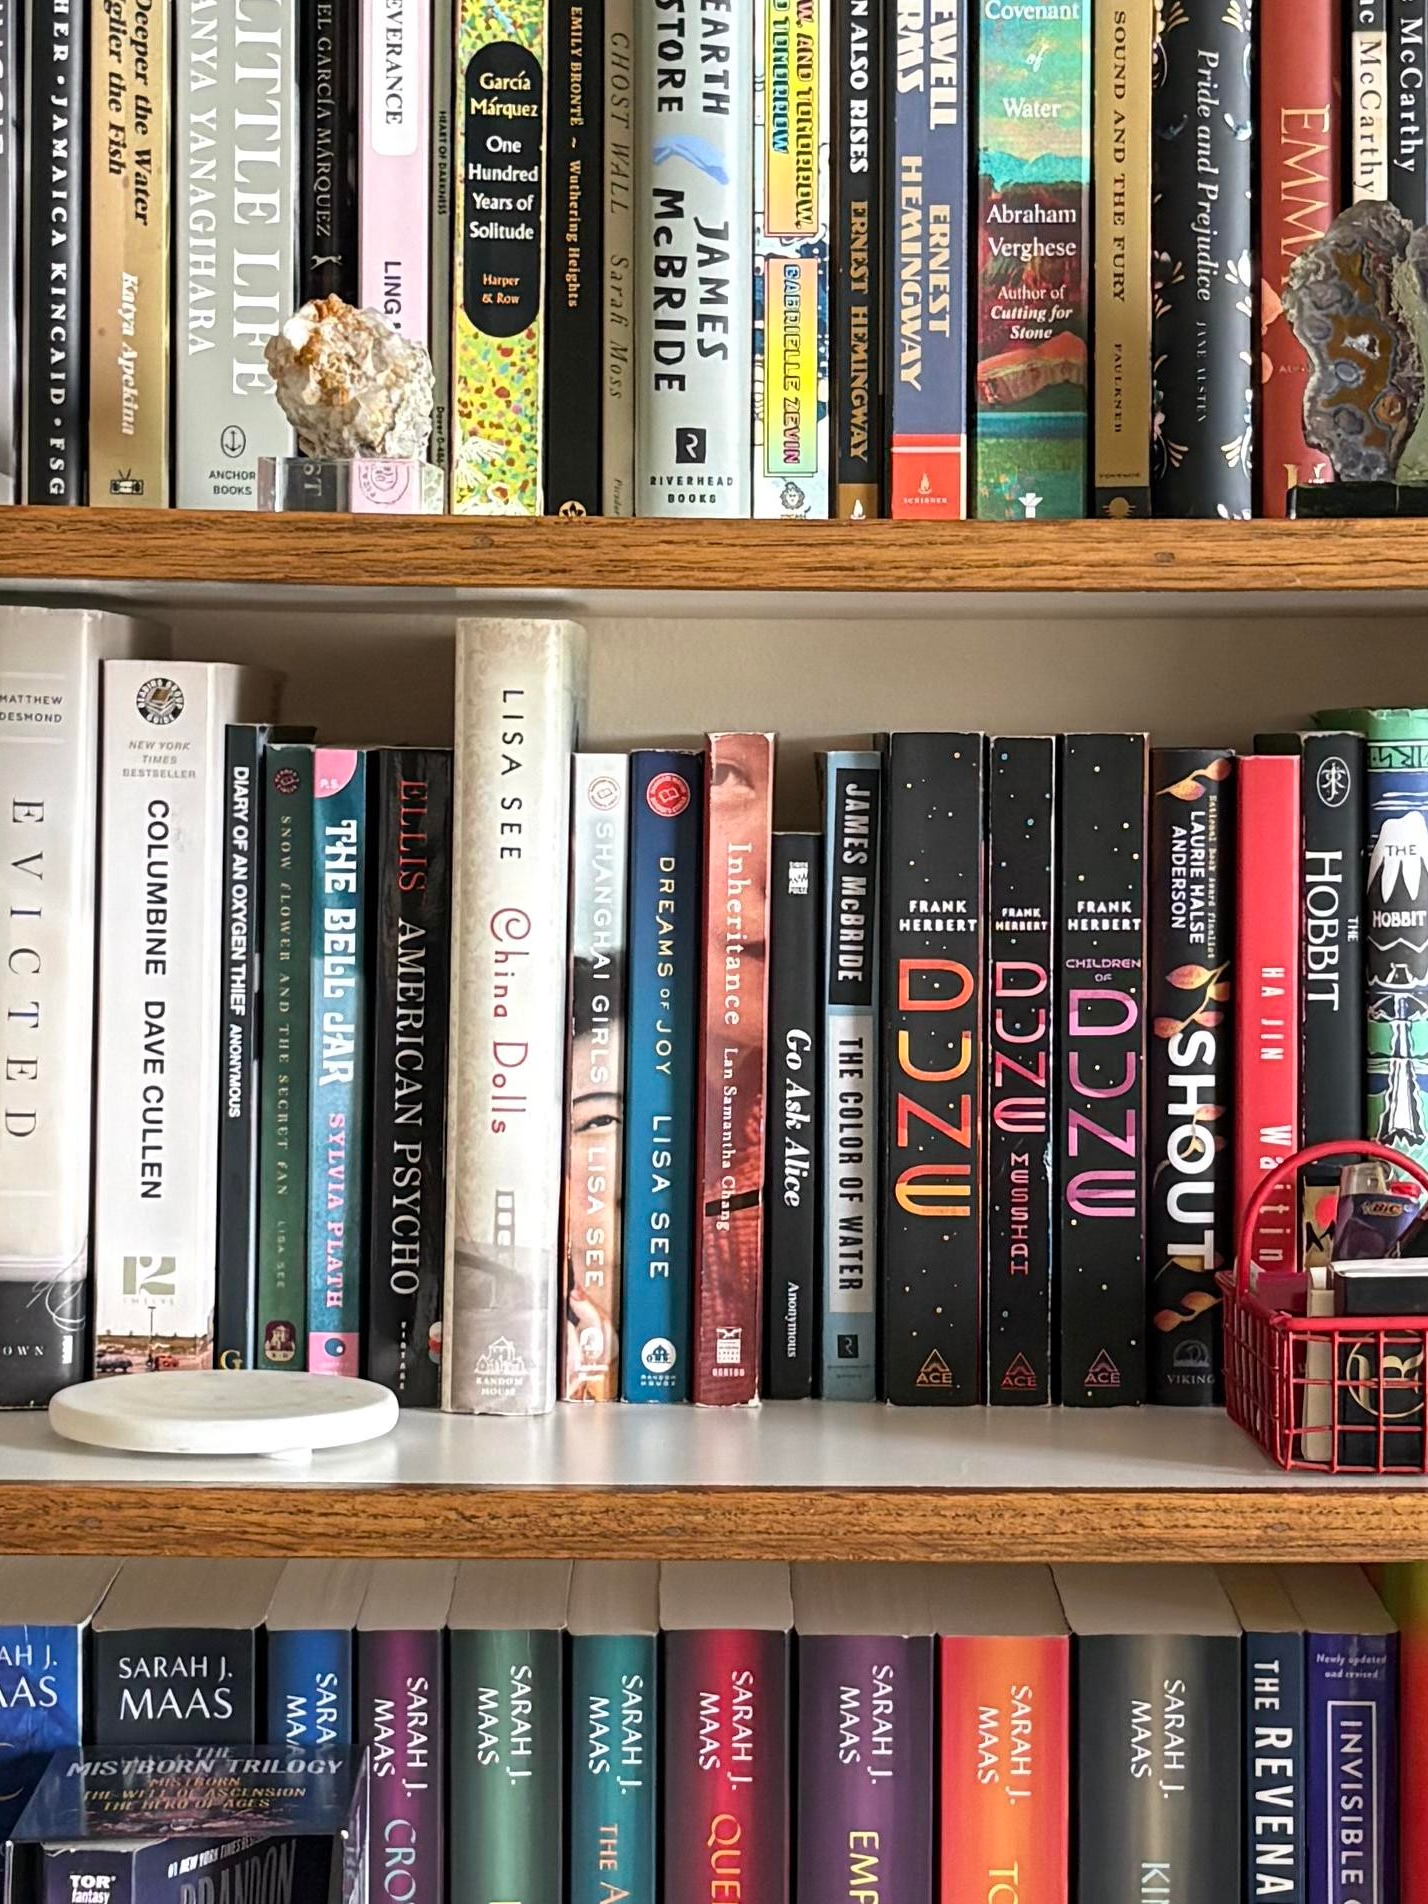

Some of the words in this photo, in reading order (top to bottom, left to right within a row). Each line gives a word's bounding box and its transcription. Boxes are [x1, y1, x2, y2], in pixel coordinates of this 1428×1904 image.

[984, 0, 1079, 21] Covenant
[1026, 45, 1045, 70] of
[479, 71, 532, 93] García
[470, 97, 539, 120] Márquez
[1002, 98, 1062, 119] Water
[486, 135, 522, 155] One
[468, 163, 539, 184] Hundred
[473, 192, 513, 212] Years
[516, 191, 534, 212] of
[469, 221, 534, 242] Solitude
[208, 469, 256, 480] ANCHOR
[650, 475, 734, 487] RIVERHEAD
[213, 485, 253, 496] BOOKS
[667, 492, 717, 504] BOOKS
[909, 900, 968, 914] FRANK
[899, 916, 978, 933] HERBERT
[894, 958, 974, 1218] DUNE
[915, 1369, 954, 1387] ACE
[1338, 1719, 1364, 1889] INVISIBLE
